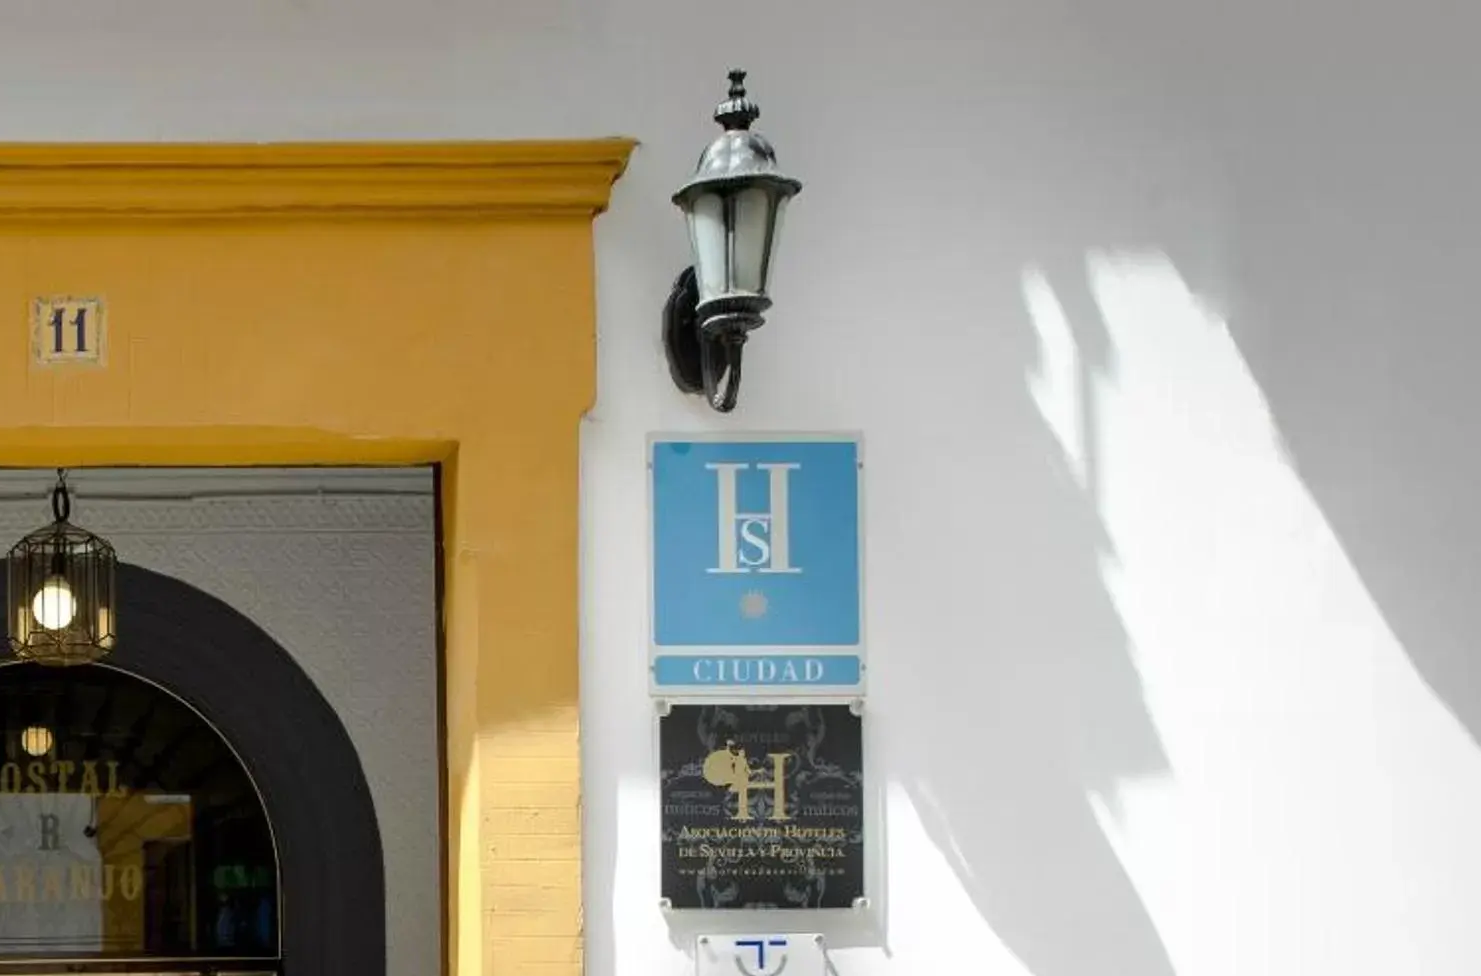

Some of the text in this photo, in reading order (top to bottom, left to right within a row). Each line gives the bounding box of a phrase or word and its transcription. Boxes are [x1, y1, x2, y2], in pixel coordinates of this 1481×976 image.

[47, 307, 89, 352] 11
[692, 659, 824, 682] CIUDAD
[37, 813, 60, 851] R
